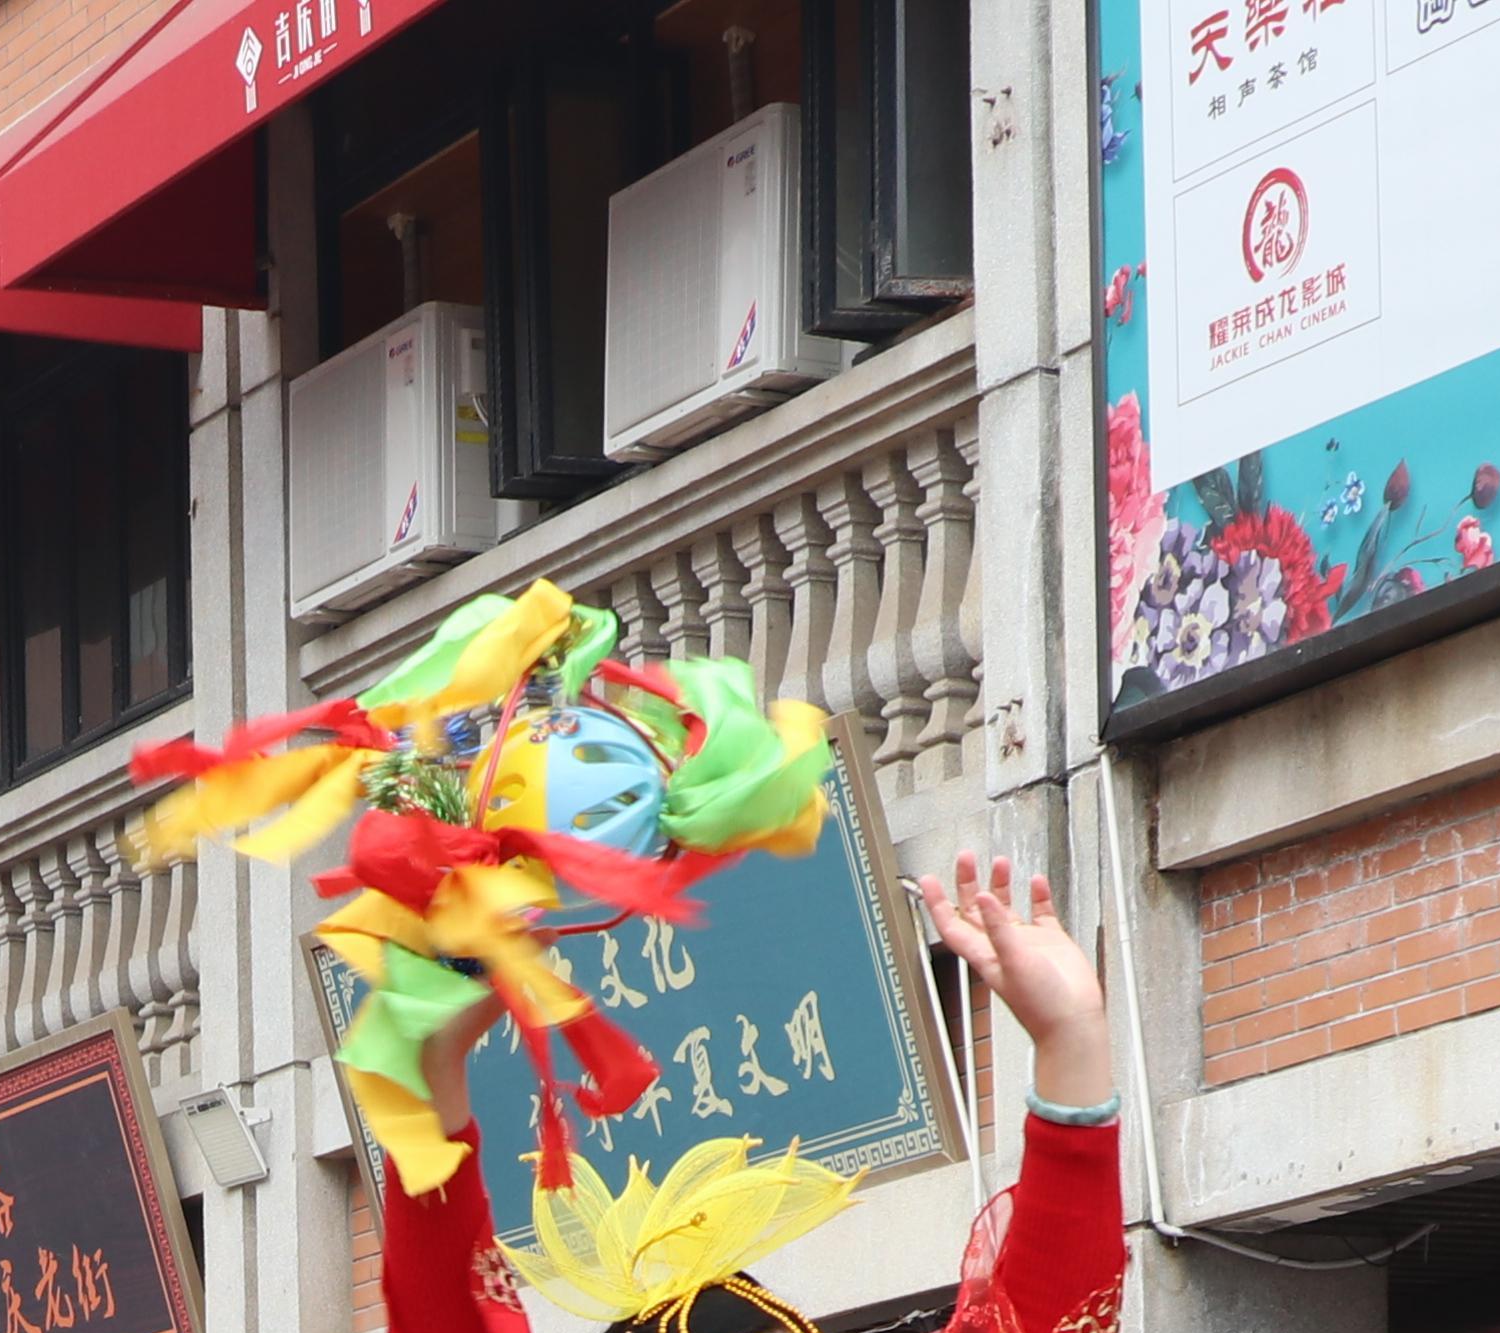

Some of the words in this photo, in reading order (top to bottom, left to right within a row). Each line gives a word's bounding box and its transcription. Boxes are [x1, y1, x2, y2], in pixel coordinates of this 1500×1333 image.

[1207, 47, 1318, 119] 相声茶馆
[1208, 263, 1347, 350] 耀莱成龙影城
[1209, 342, 1250, 371] JACKIE
[1258, 324, 1293, 349] CHAN
[1300, 299, 1347, 331] CINEMA
